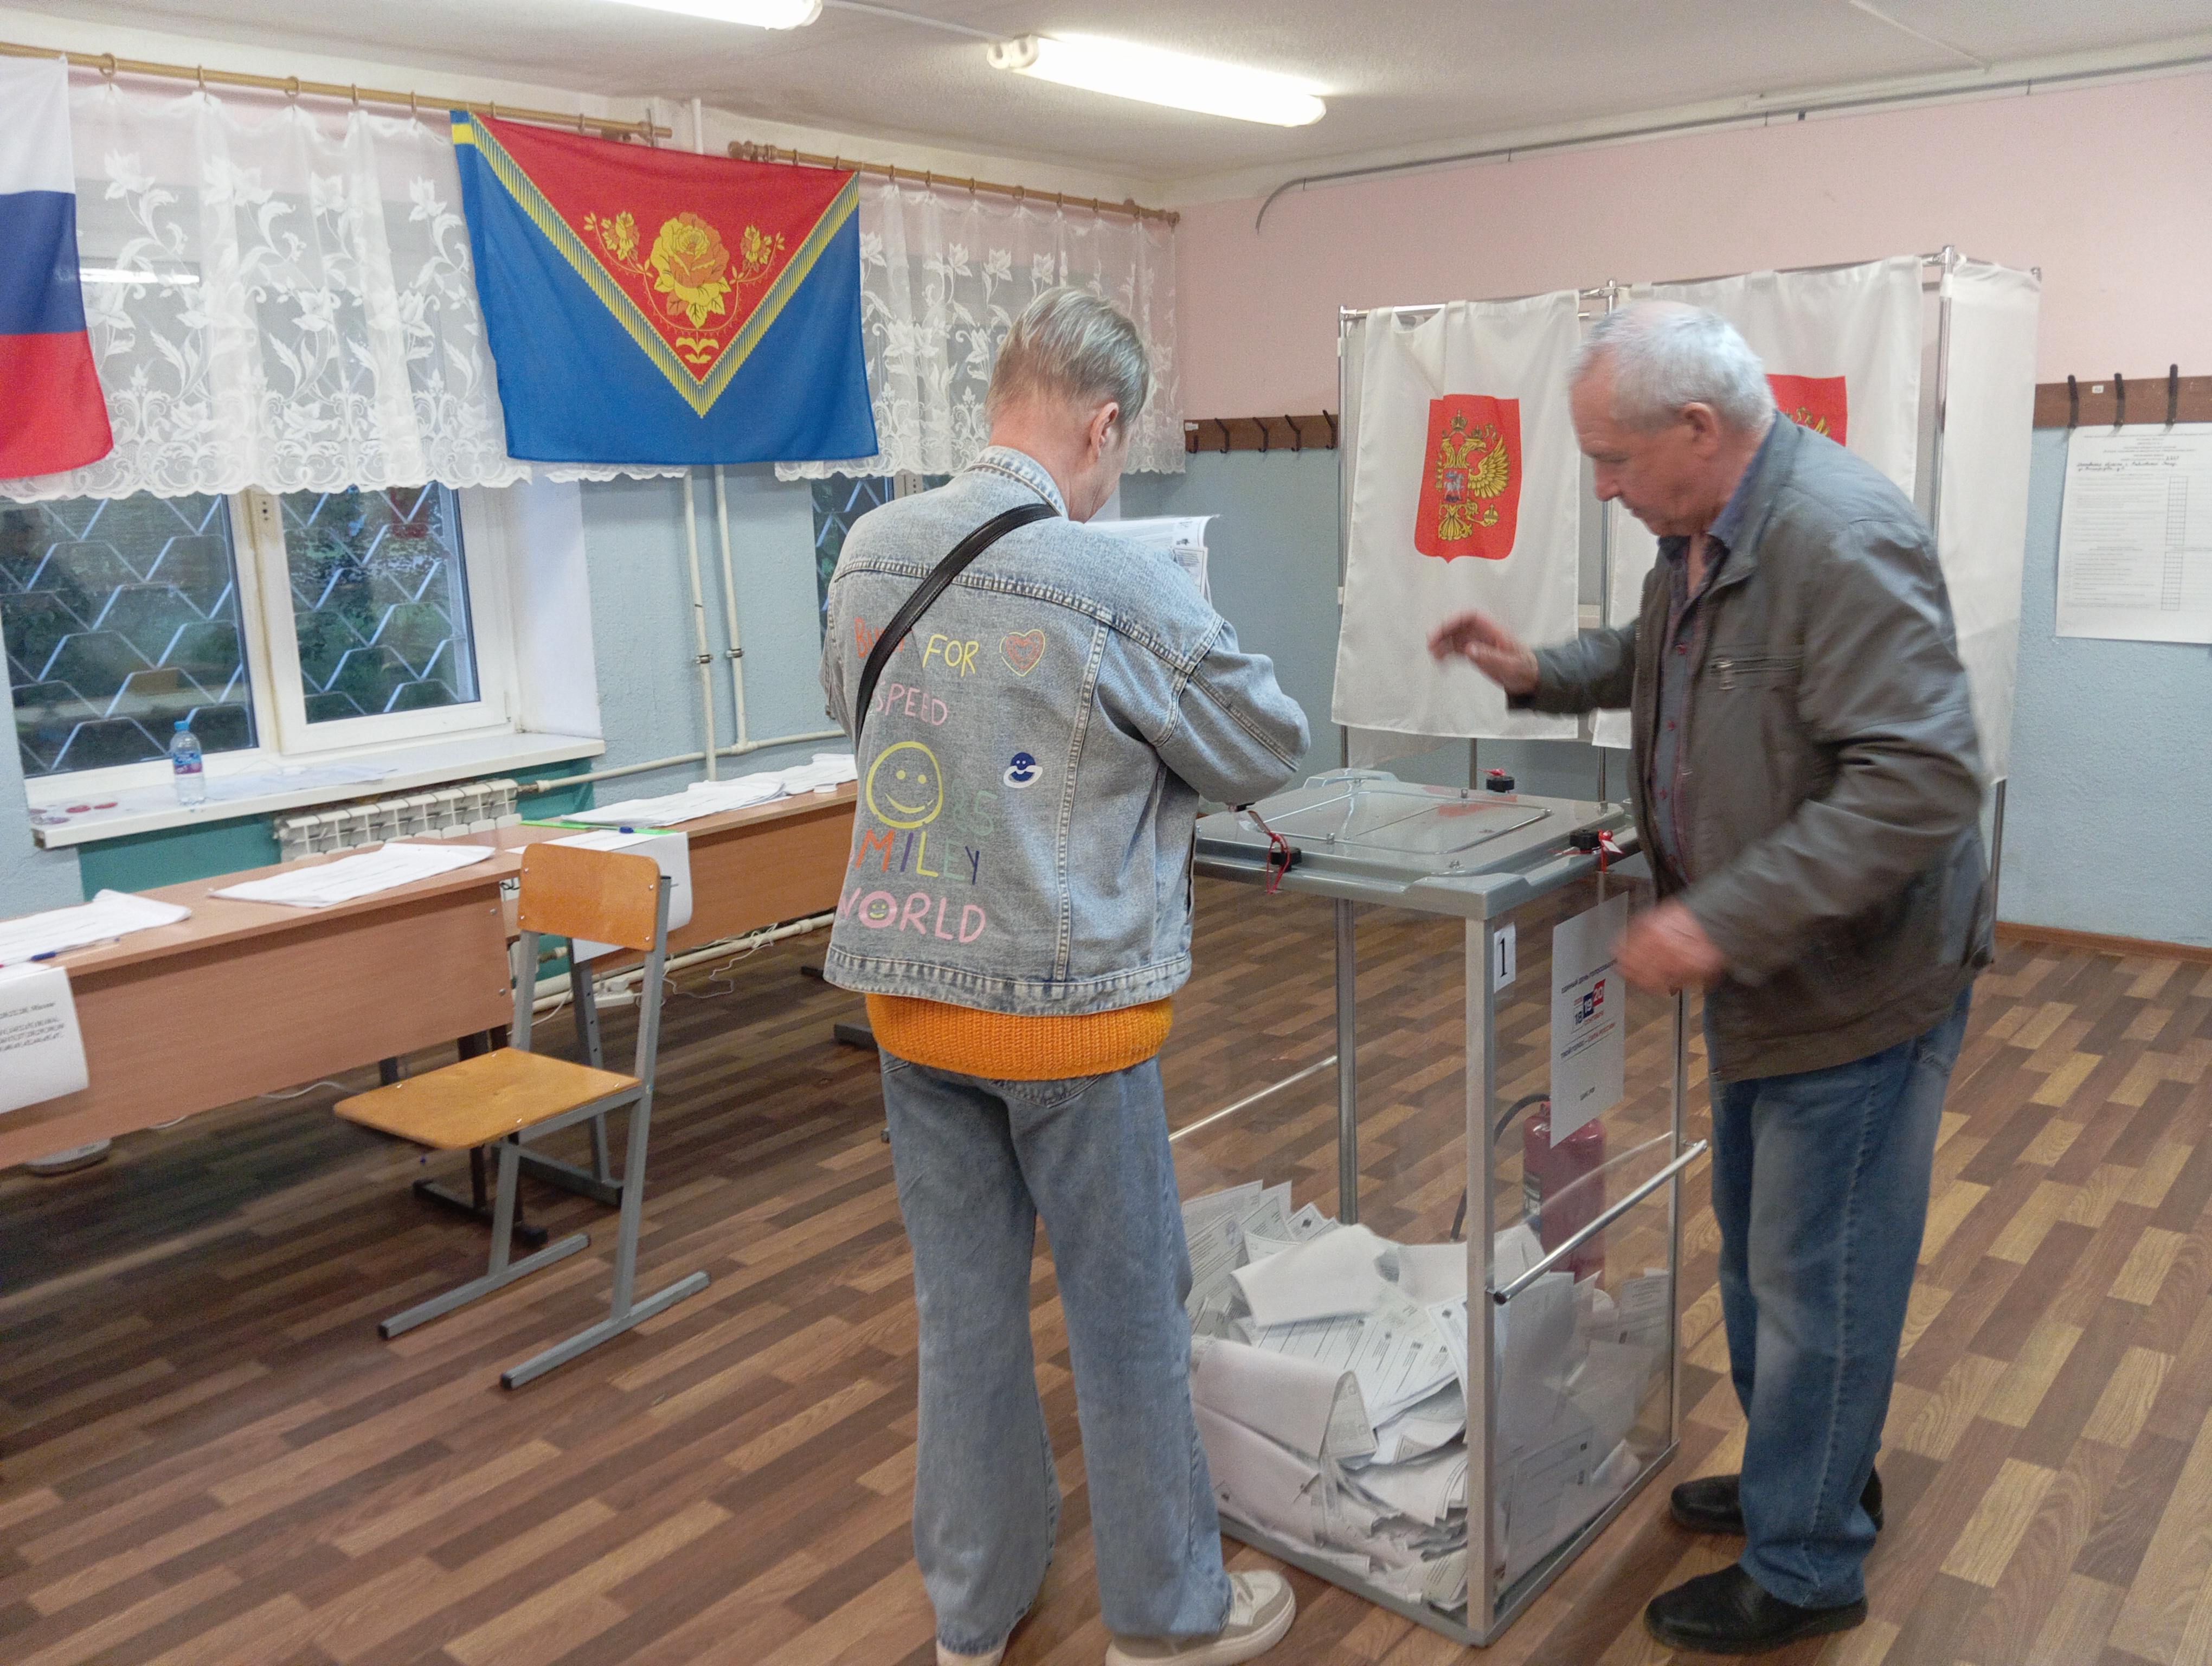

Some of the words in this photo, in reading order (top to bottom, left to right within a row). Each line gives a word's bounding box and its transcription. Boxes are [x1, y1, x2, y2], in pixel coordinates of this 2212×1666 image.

[923, 633, 979, 677] FOR
[874, 681, 948, 726] SPEED
[854, 829, 980, 885] MILEY
[837, 887, 986, 943] WORLD
[1500, 937, 1508, 977] 1
[1575, 1010, 1583, 1025] 18
[1584, 998, 1593, 1014] 19
[1593, 986, 1603, 1002] 20
